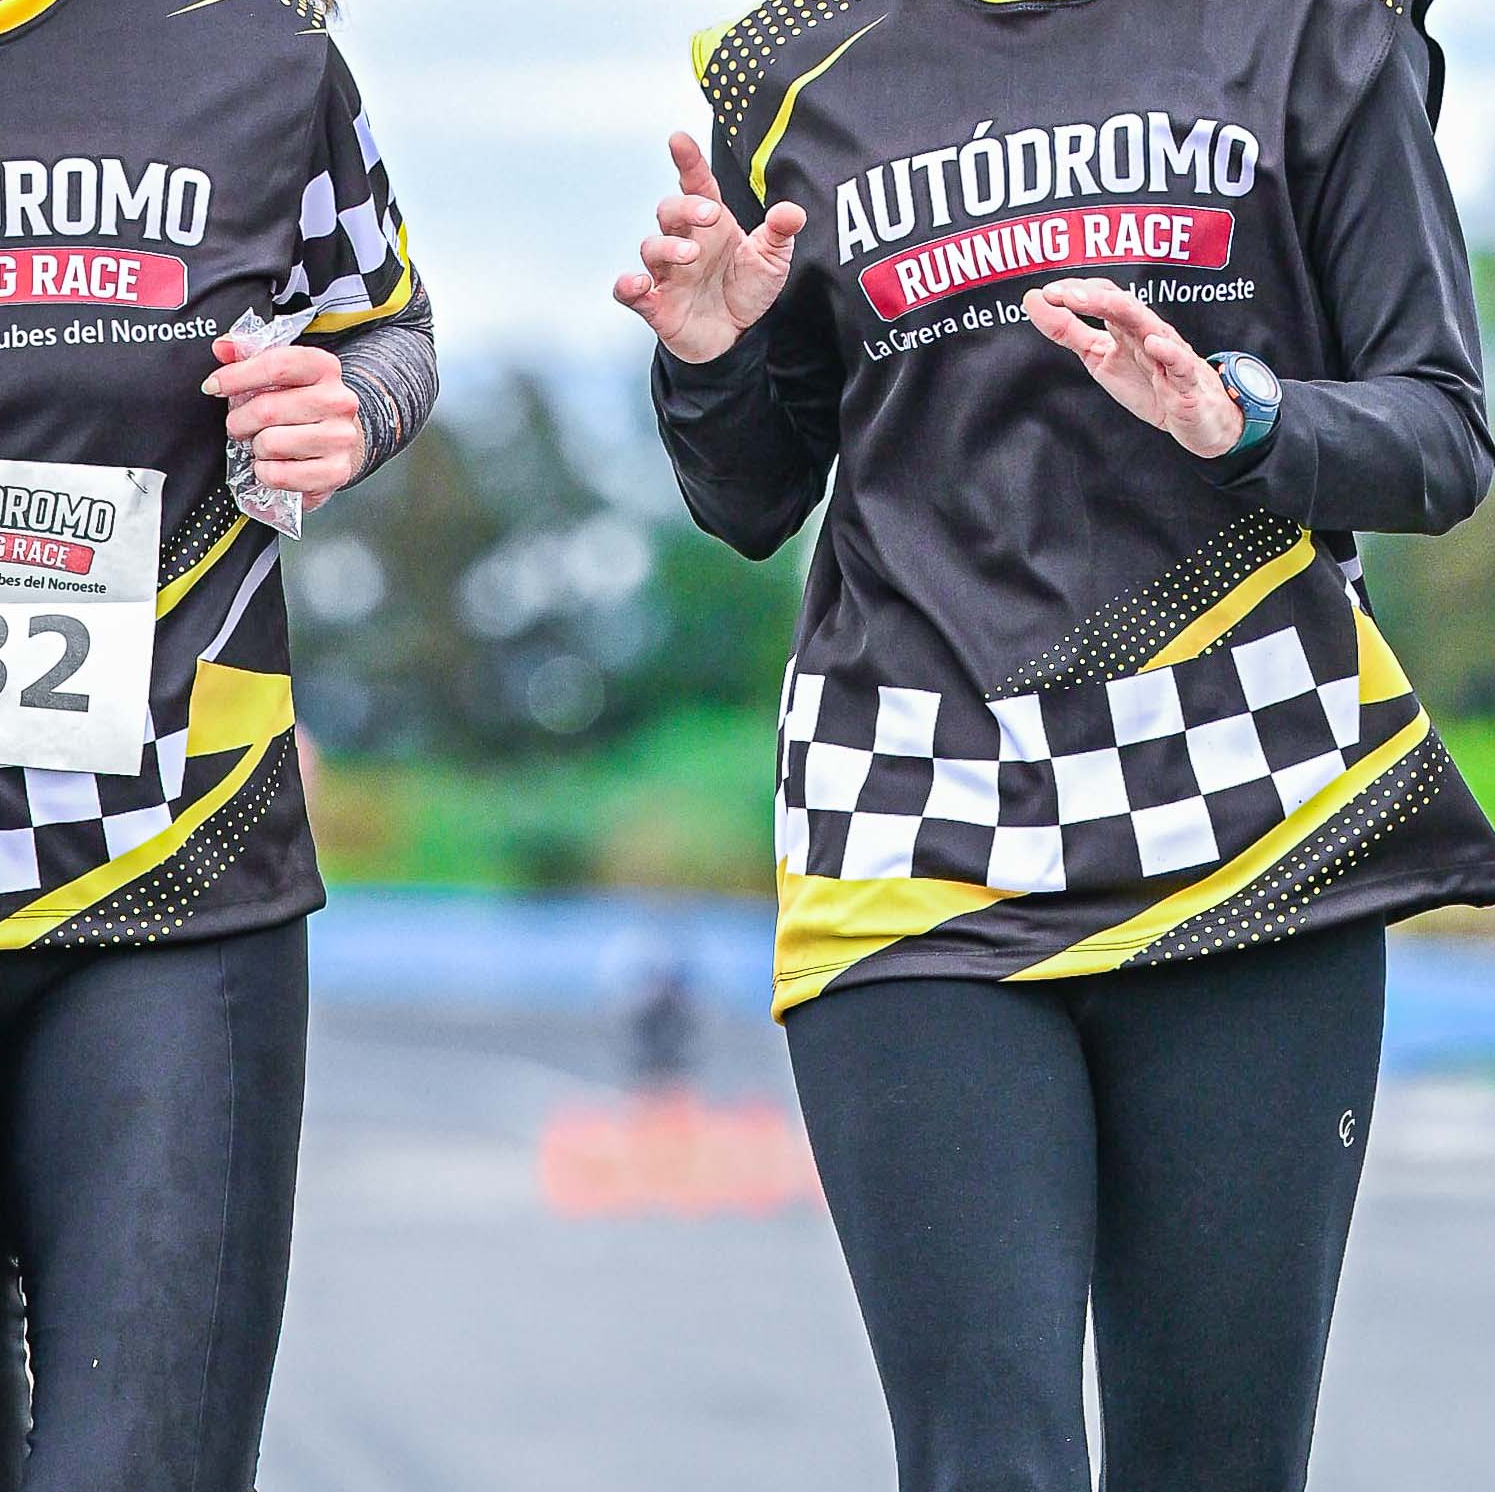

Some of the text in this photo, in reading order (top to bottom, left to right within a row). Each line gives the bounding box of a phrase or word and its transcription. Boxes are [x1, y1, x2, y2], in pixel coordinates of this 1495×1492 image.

[835, 112, 1260, 265] AUTÓDROMO
[30, 254, 141, 301] RACE
[894, 212, 1192, 306] RUNNING RACE
[63, 319, 104, 344] del
[111, 315, 217, 343] Noroeste
[864, 340, 892, 361] La
[962, 305, 994, 330] de
[1158, 277, 1255, 304] Noroeste
[11, 537, 71, 569] RACE
[23, 575, 45, 590] del
[48, 577, 107, 594] Noroeste
